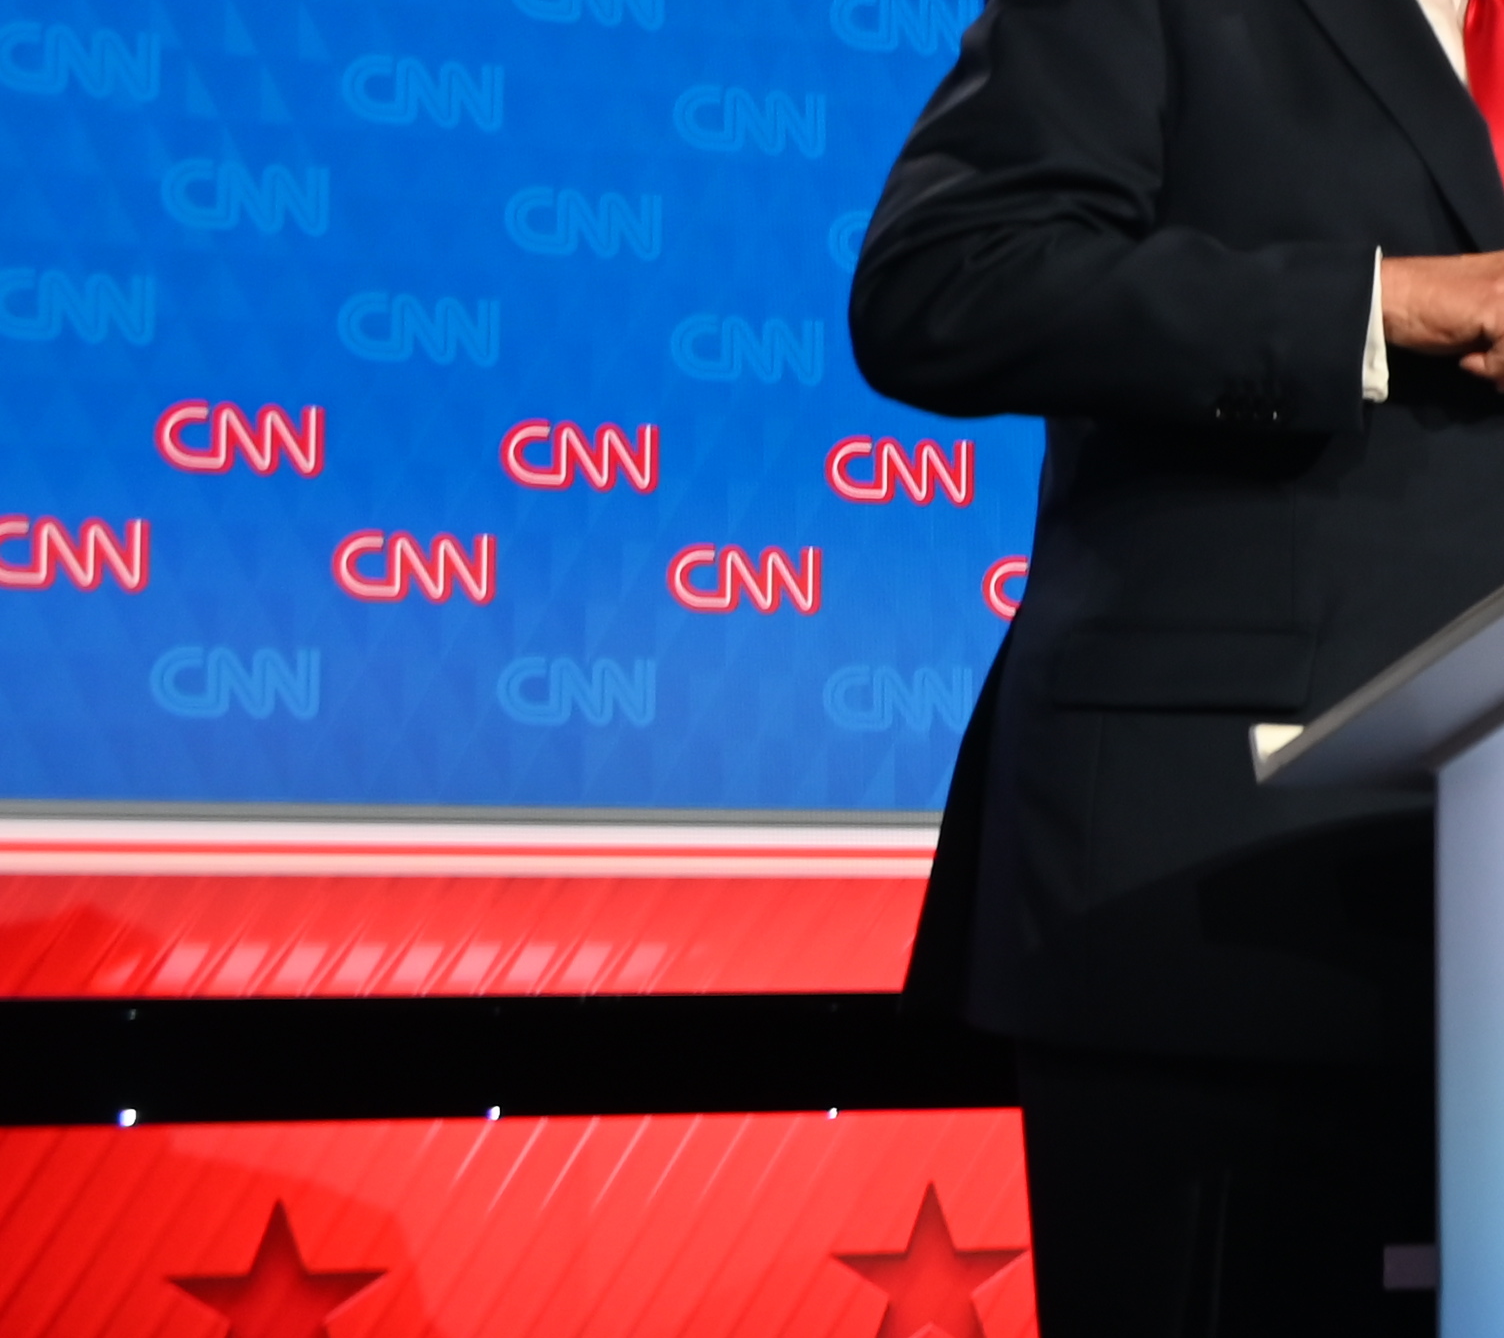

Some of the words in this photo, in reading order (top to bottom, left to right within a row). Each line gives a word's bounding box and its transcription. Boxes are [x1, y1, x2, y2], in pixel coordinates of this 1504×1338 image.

[0, 22, 161, 101] CNN
[342, 55, 505, 132] CNN
[674, 85, 827, 158] CNN
[162, 160, 330, 237] CNN
[505, 188, 662, 261] CNN
[0, 270, 155, 347] CNN
[338, 293, 501, 368] CNN
[671, 314, 825, 387] CNN
[155, 399, 327, 478] CNN
[501, 419, 659, 494] CNN
[825, 435, 975, 506] CNN
[0, 516, 149, 593] CNN
[334, 529, 495, 604] CNN
[667, 543, 821, 613] CNN
[151, 647, 321, 721] CNN
[498, 656, 656, 728] CNN
[823, 665, 975, 734] CNN
